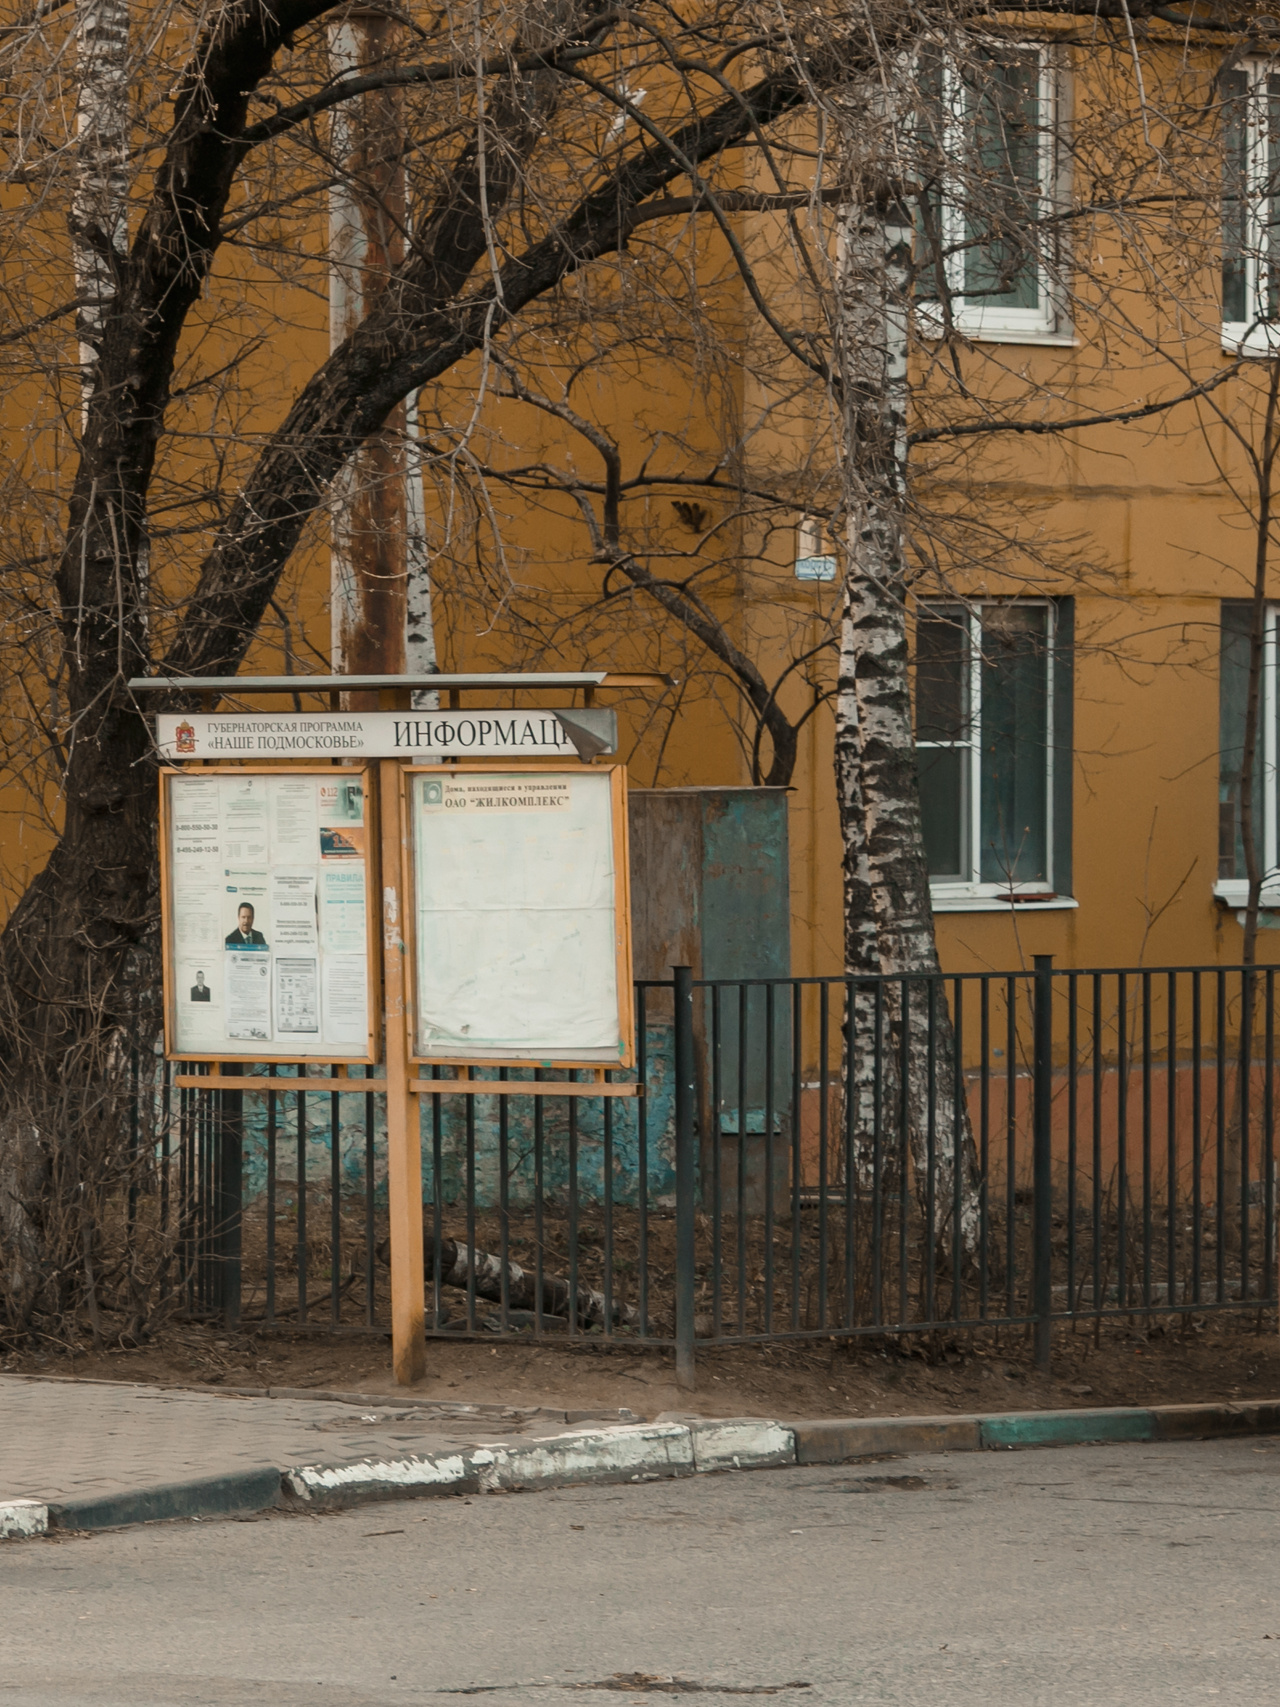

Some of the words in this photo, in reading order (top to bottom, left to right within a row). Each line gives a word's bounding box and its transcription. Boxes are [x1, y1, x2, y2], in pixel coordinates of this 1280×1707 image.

[207, 722, 297, 733] ГУБЕРНАТОРСКАЯ
[300, 721, 364, 732] ПРОГРАММА
[207, 736, 254, 749] «НАШЕ
[257, 735, 364, 750] ПОДМОСКОВЬЕ»
[445, 785, 466, 793] Дома,
[524, 784, 567, 792] управлении
[445, 798, 467, 808] ОАО
[332, 835, 354, 848] 112
[326, 873, 364, 882] ПРАВИЛА
